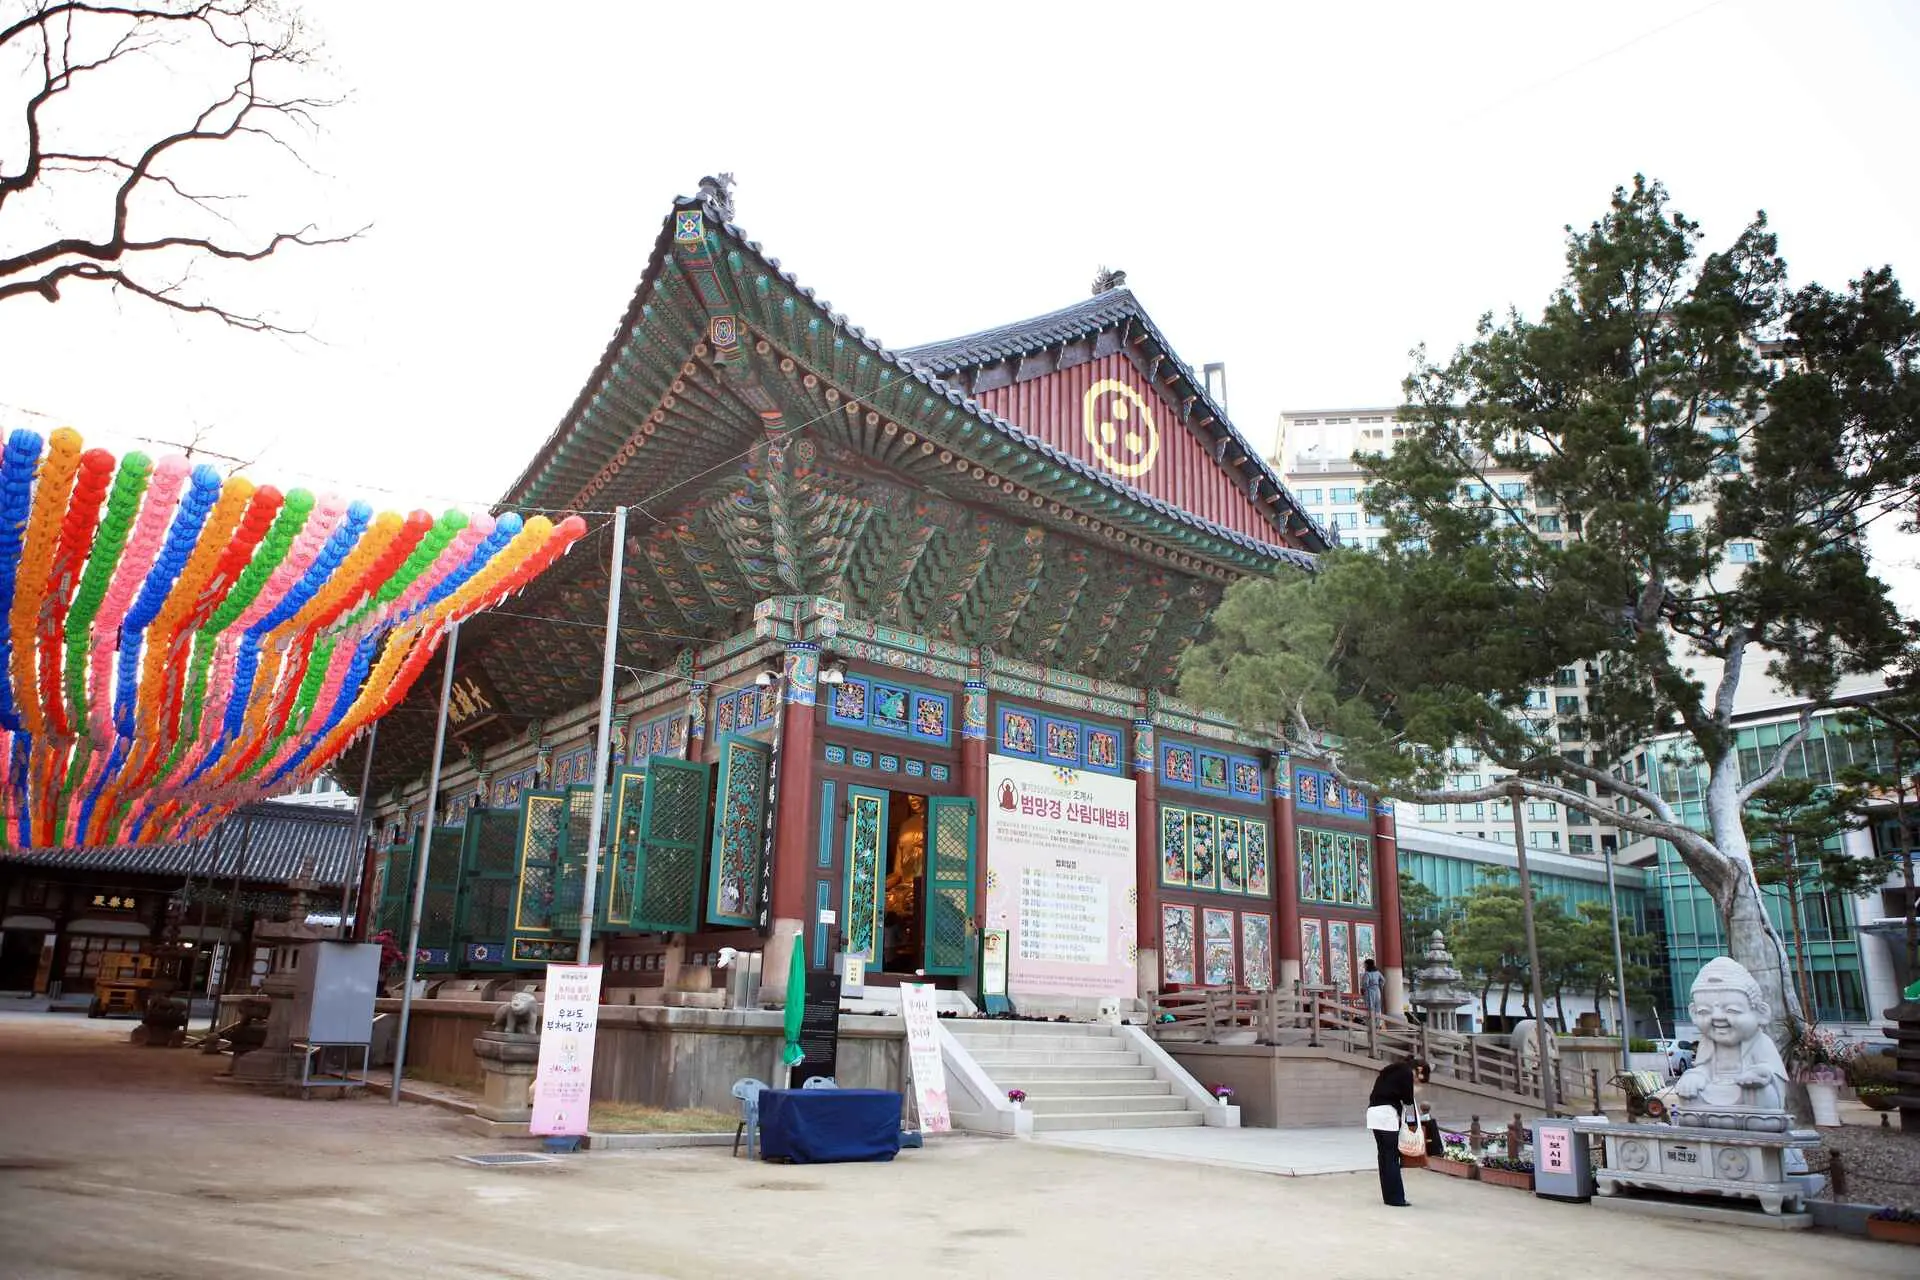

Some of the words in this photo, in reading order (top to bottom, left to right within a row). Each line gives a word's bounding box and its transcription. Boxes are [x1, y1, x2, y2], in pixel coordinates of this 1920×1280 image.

[1073, 790, 1093, 802] 조계사
[1021, 794, 1062, 820] 범망경
[1066, 801, 1129, 830] 산림대법회
[558, 1008, 584, 1019] 우리도
[546, 1020, 572, 1032] 부처님
